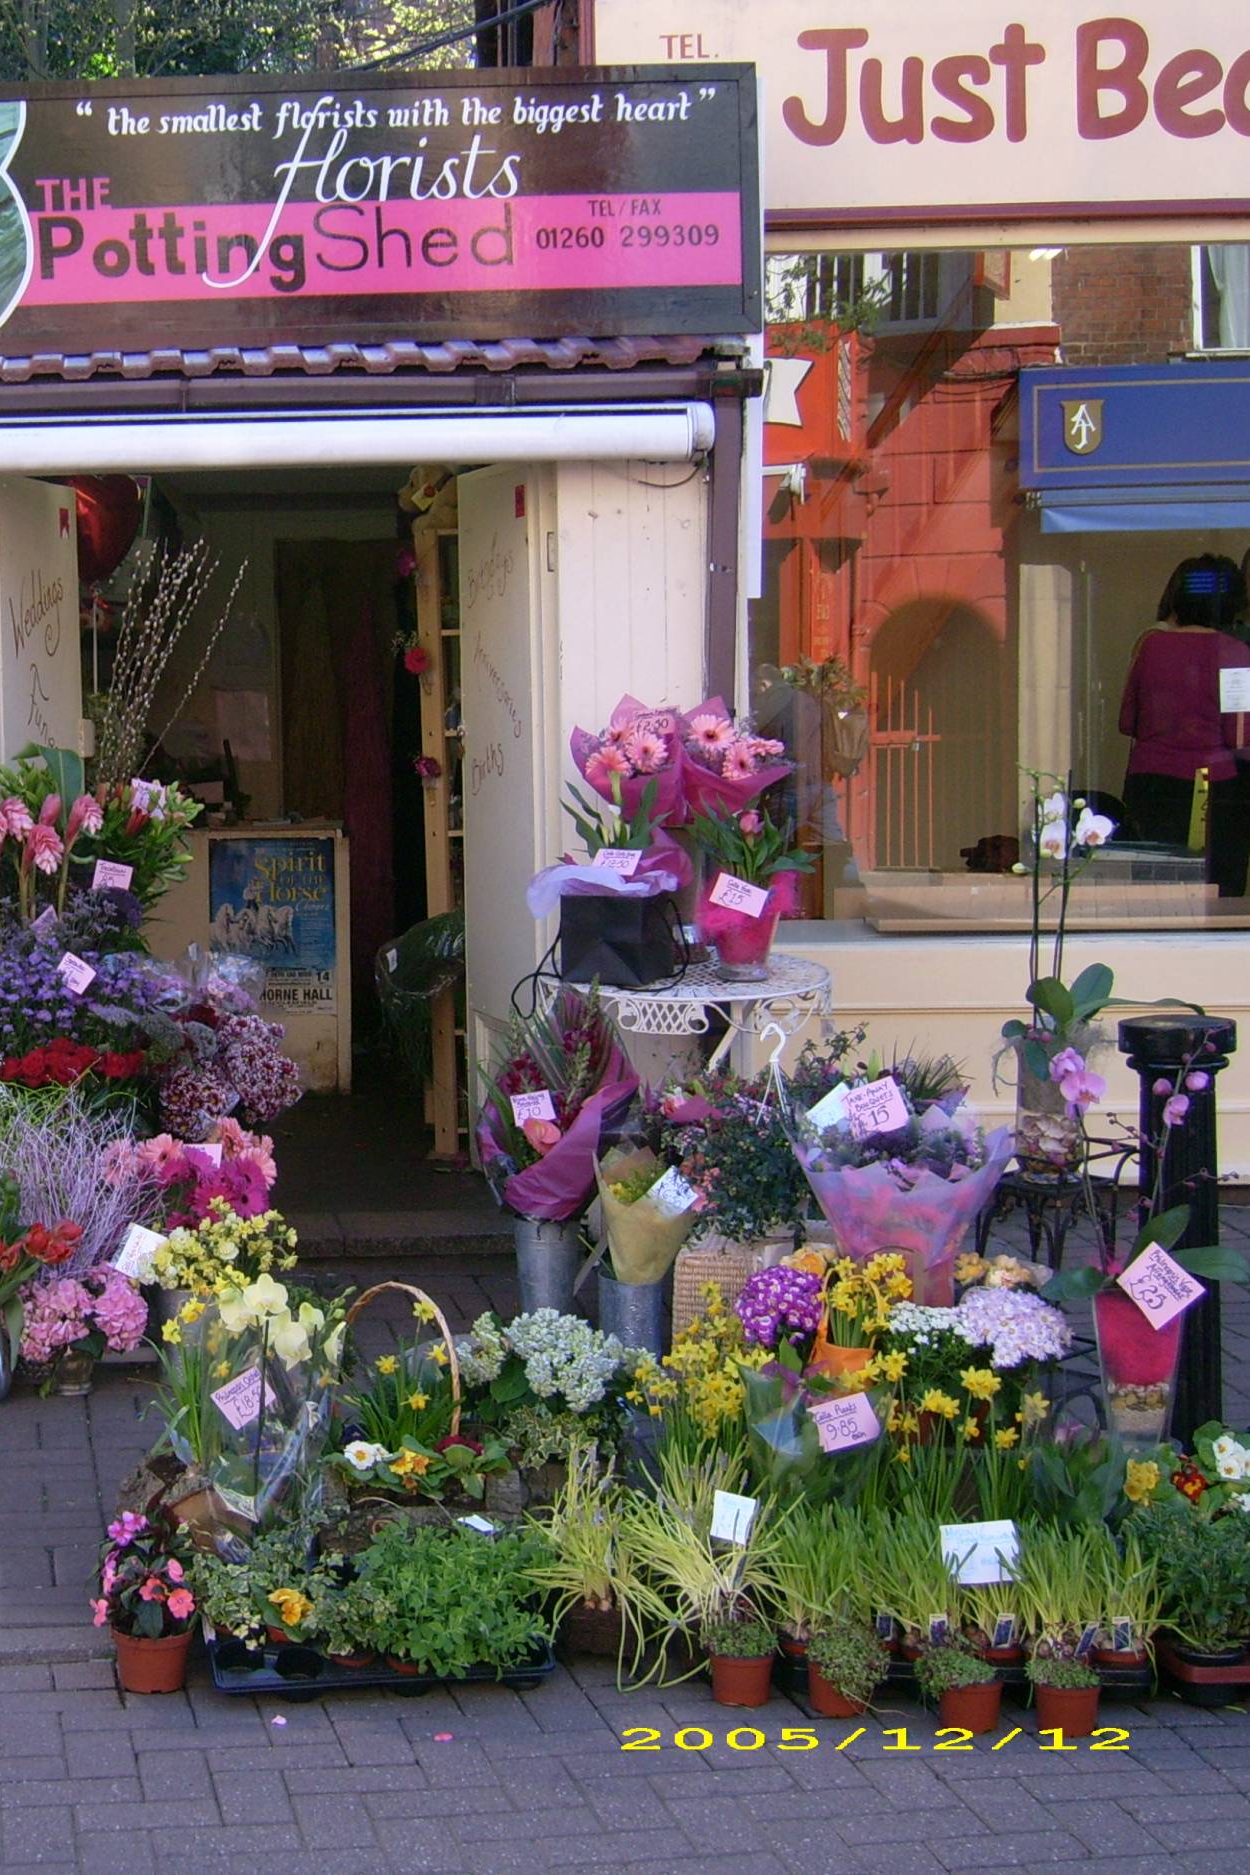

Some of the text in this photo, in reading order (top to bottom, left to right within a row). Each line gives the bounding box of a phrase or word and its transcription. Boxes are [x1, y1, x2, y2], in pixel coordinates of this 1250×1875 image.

[659, 34, 720, 60] TEL.
[782, 22, 1046, 147] Just
[158, 103, 262, 134] smallest
[272, 99, 377, 140] florists
[388, 97, 449, 127] with
[461, 95, 502, 126] the
[513, 93, 603, 134] biggest
[35, 176, 112, 211] THE
[203, 96, 520, 288] Florists
[38, 201, 514, 292] Potting Shed
[536, 223, 720, 249] 01260 299309
[9, 569, 63, 658] Weddings
[254, 849, 326, 881] Spirit
[303, 988, 333, 1001] HALL
[1130, 1275, 1167, 1310] £25
